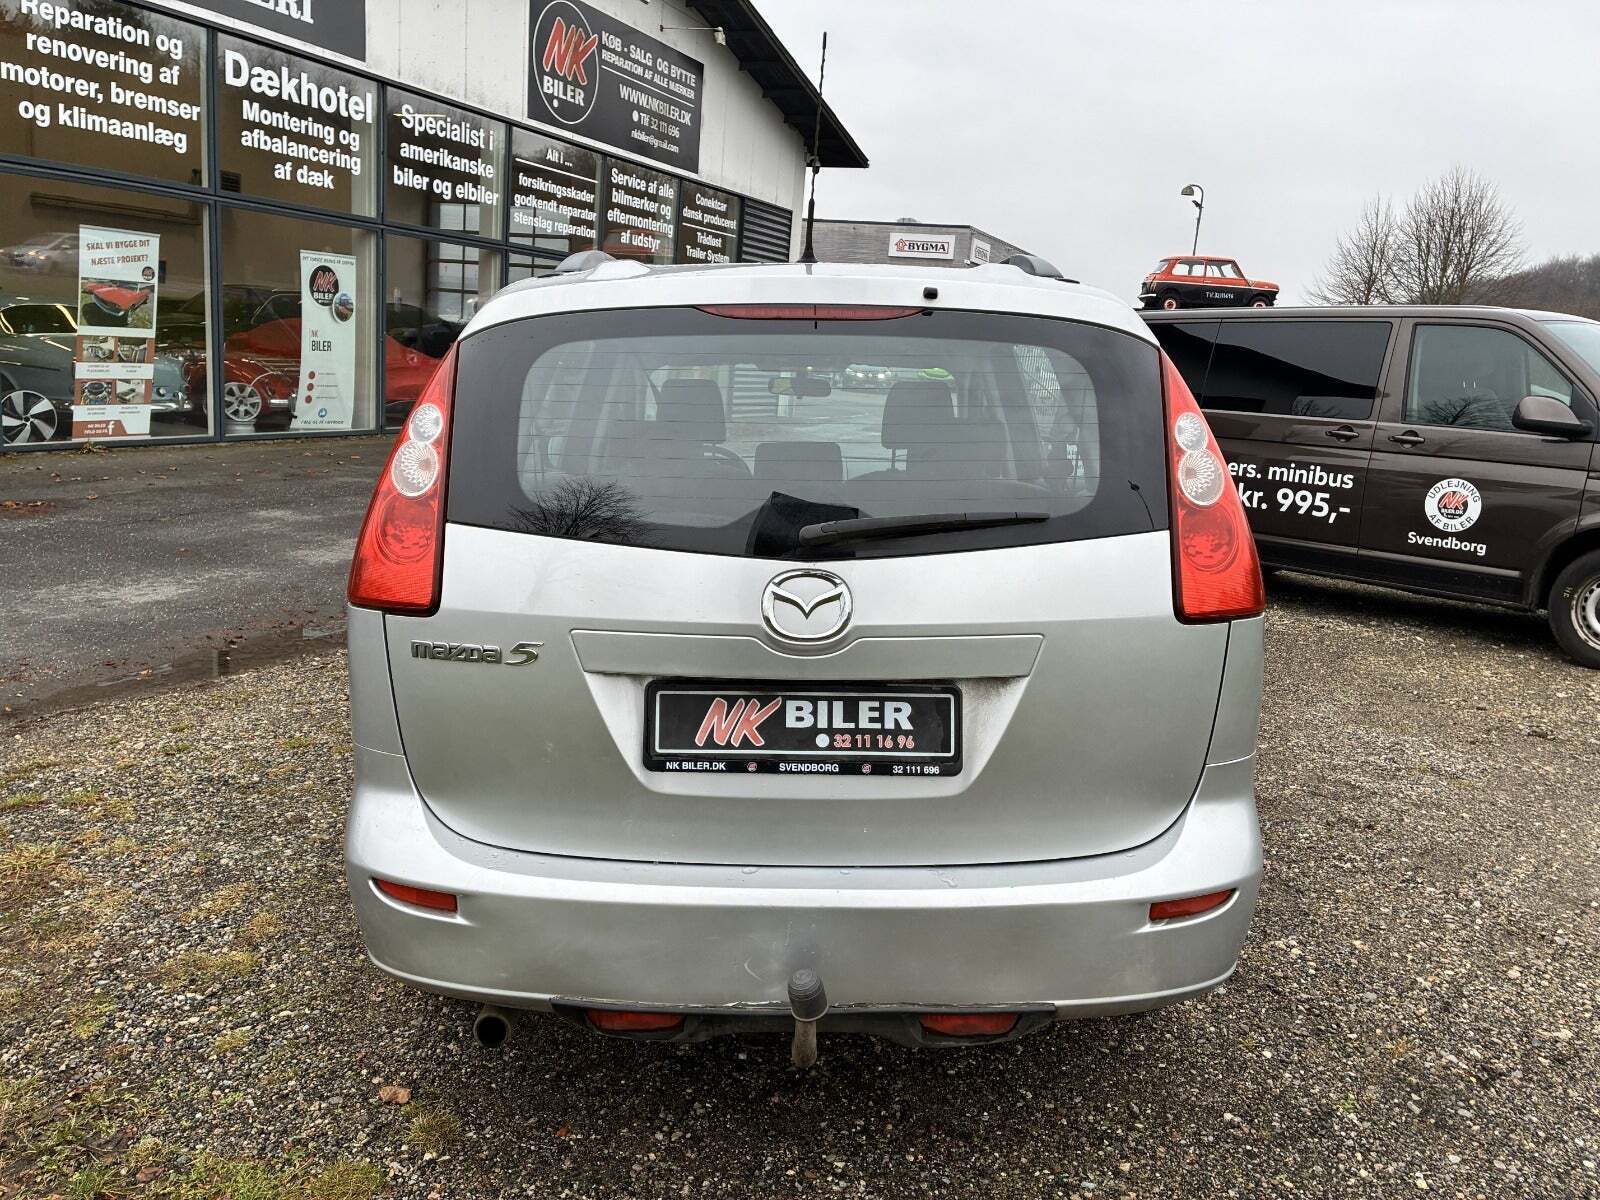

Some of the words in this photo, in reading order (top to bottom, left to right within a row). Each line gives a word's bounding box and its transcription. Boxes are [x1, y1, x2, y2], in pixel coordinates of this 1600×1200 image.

[20, 0, 150, 46] Reparation
[156, 34, 183, 60] og
[26, 33, 153, 84] renovering
[159, 65, 180, 85] af
[542, 16, 599, 85] NK
[601, 30, 623, 52] KØB
[629, 44, 653, 67] SALG
[656, 58, 670, 75] OG
[670, 64, 697, 88] BYTTE
[225, 49, 373, 124] Dækhotel
[601, 48, 644, 77] REPARATION
[643, 68, 654, 81] AF
[653, 73, 669, 88] ALLE
[668, 80, 696, 100] MÆRKER
[1, 61, 104, 104] motorer,
[110, 82, 201, 121] bremser
[543, 74, 585, 107] BILER
[619, 83, 692, 127] WWW.NKBILER.DK
[18, 100, 51, 127] og
[58, 103, 188, 154] klimaanlæg
[242, 99, 335, 146] Montering
[339, 129, 360, 152] og
[401, 103, 485, 149] Specialist
[489, 129, 494, 151] i
[650, 116, 659, 131] 32
[659, 120, 669, 135] 111
[668, 124, 681, 139] 696
[241, 129, 361, 176] afbalancering
[630, 128, 679, 154] nkbiler@gmail.com
[400, 143, 494, 178] amerikanske
[546, 147, 559, 164] Alt
[274, 162, 293, 181] af
[296, 165, 335, 190] dæk
[393, 164, 430, 191] biler
[432, 178, 453, 200] og
[455, 181, 499, 206] elbiler
[518, 172, 595, 204] forsikringsskader
[611, 167, 647, 191] Service
[647, 181, 658, 195] af
[658, 183, 674, 199] alle
[513, 193, 559, 213] godkendt
[558, 202, 598, 222] reparatør
[611, 187, 658, 213] bilmærker
[660, 204, 672, 220] og
[513, 211, 553, 233] stenslag
[554, 221, 597, 239] reparation
[607, 207, 674, 239] eftermontering
[682, 206, 703, 220] dansk
[703, 211, 737, 231] produceret
[86, 242, 105, 252] SKAL
[105, 241, 114, 250] VI
[114, 241, 138, 249] BYGGE
[620, 231, 631, 245] af
[632, 234, 661, 253] udstyr
[696, 231, 722, 248] Trådløst
[908, 243, 947, 252] BYGMA
[685, 245, 708, 260] Trailer
[706, 250, 730, 264] System
[312, 270, 337, 292] NK
[311, 340, 332, 352] BILER
[1267, 463, 1355, 489] minibus
[1238, 482, 1268, 510] kr.
[1276, 487, 1351, 524] 995,-
[1428, 481, 1481, 503] UDLEJNING
[1439, 491, 1469, 509] NK
[1429, 513, 1442, 525] AF
[1443, 516, 1474, 531] BILER
[1408, 532, 1487, 556] Svendborg
[503, 640, 545, 667] 5
[695, 696, 783, 748] NK
[785, 700, 915, 731] BILER
[833, 734, 852, 749] 32
[854, 734, 872, 748] 11
[876, 735, 893, 749] 16
[897, 735, 915, 749] 96
[665, 761, 681, 771] NK
[682, 761, 727, 771] BILER.DK
[778, 763, 840, 773] SVENDBORG
[892, 765, 905, 775] 32
[906, 765, 922, 775] 111
[923, 766, 941, 775] 696
